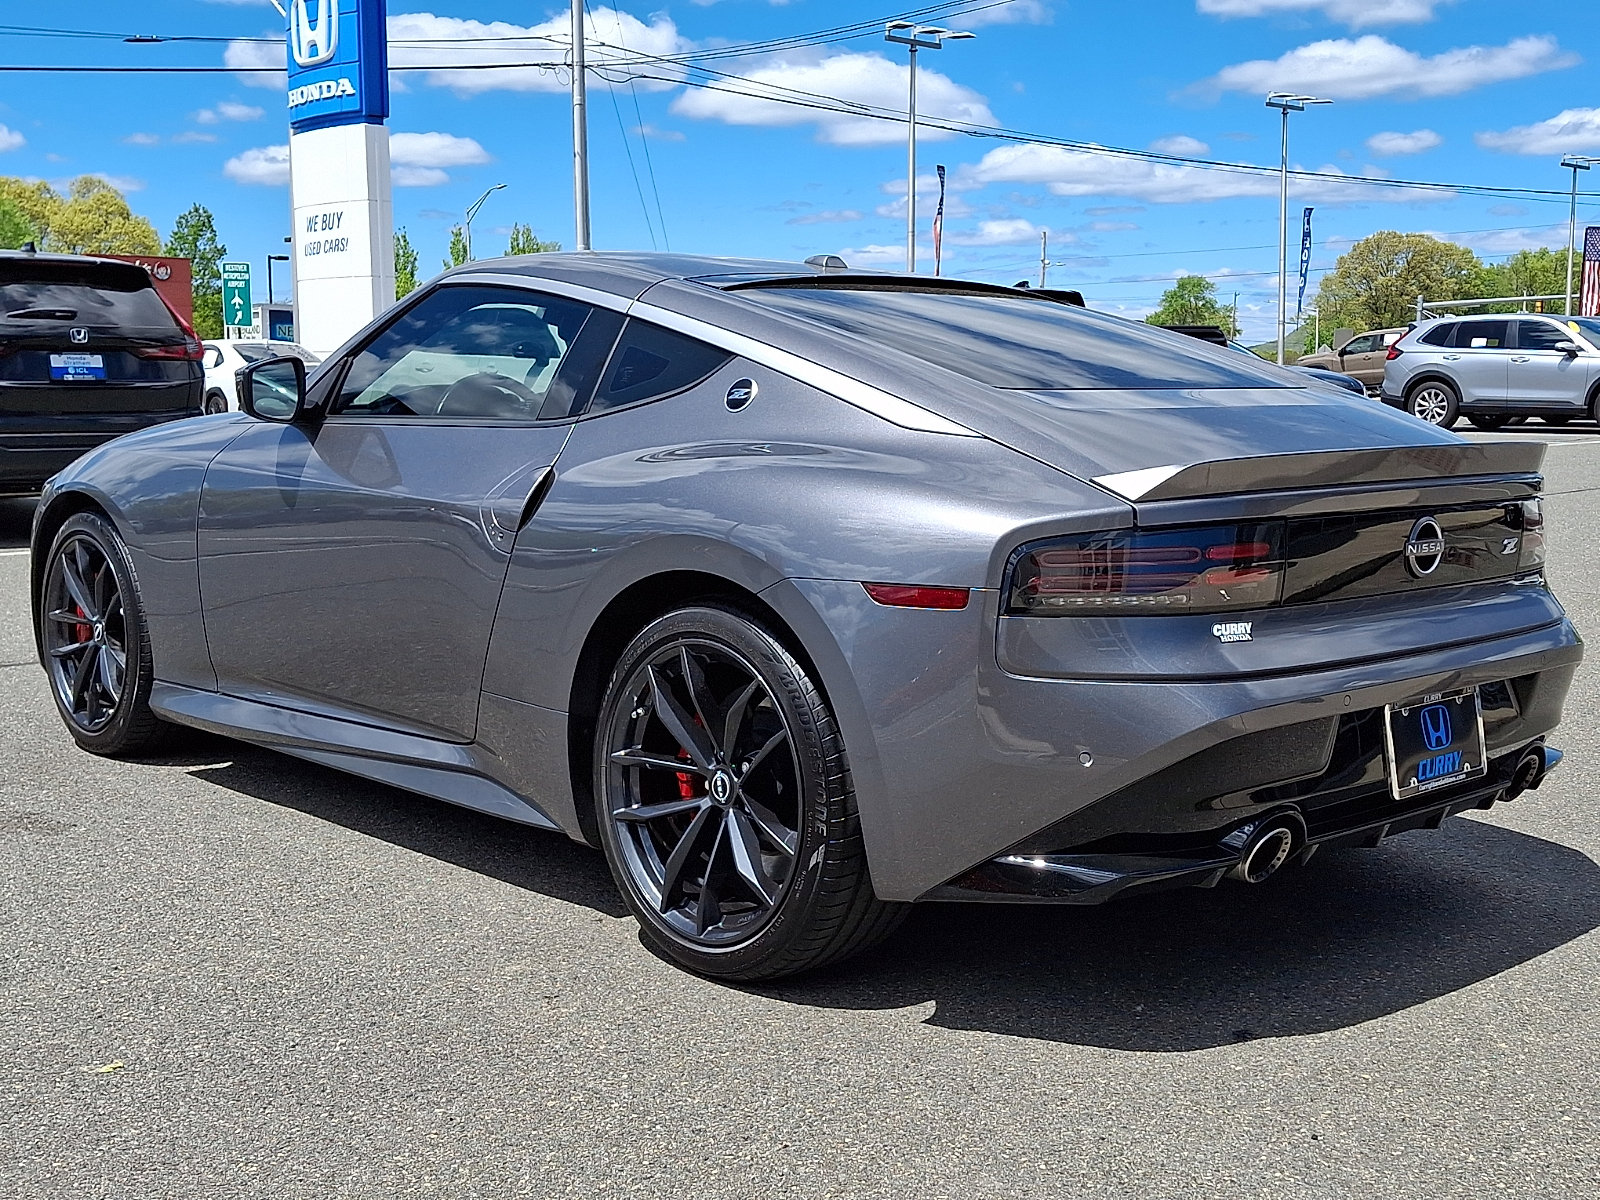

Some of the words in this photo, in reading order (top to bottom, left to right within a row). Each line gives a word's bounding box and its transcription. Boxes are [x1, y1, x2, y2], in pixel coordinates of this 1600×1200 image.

[287, 78, 356, 109] HONDA
[306, 214, 319, 233] WE
[321, 211, 344, 231] BUY
[304, 241, 321, 257] USED
[323, 237, 349, 254] CARS!
[1407, 542, 1443, 555] NISSA
[1500, 537, 1519, 555] Z
[1213, 622, 1252, 637] CURRY
[1220, 633, 1253, 643] HONDA
[1418, 750, 1463, 781] CURRY
